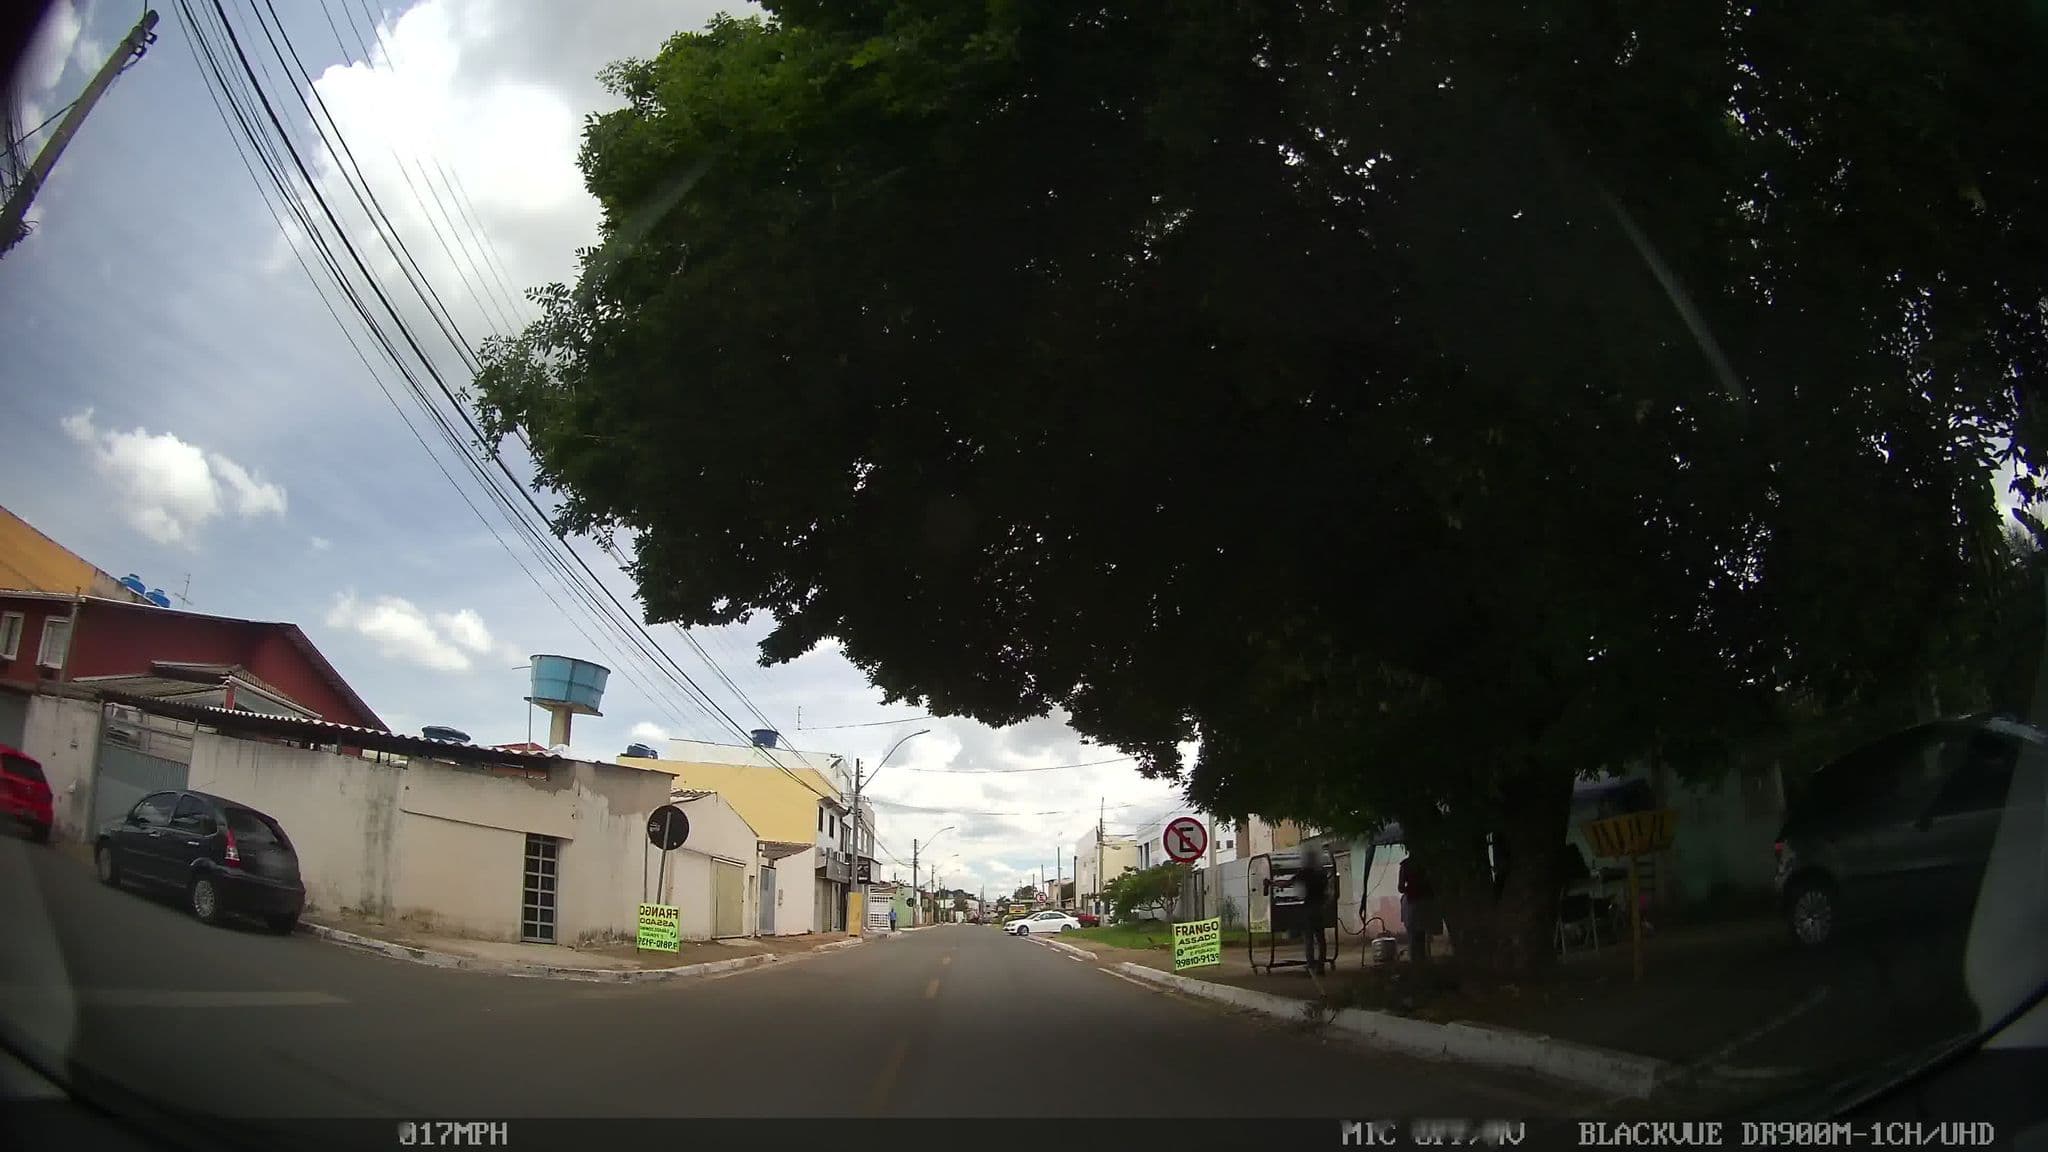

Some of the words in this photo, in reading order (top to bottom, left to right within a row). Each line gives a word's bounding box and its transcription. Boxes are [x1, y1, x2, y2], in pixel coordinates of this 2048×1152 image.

[1179, 827, 1197, 852] E
[1175, 921, 1219, 936] FRANGO
[1178, 933, 1217, 945] ASSADO
